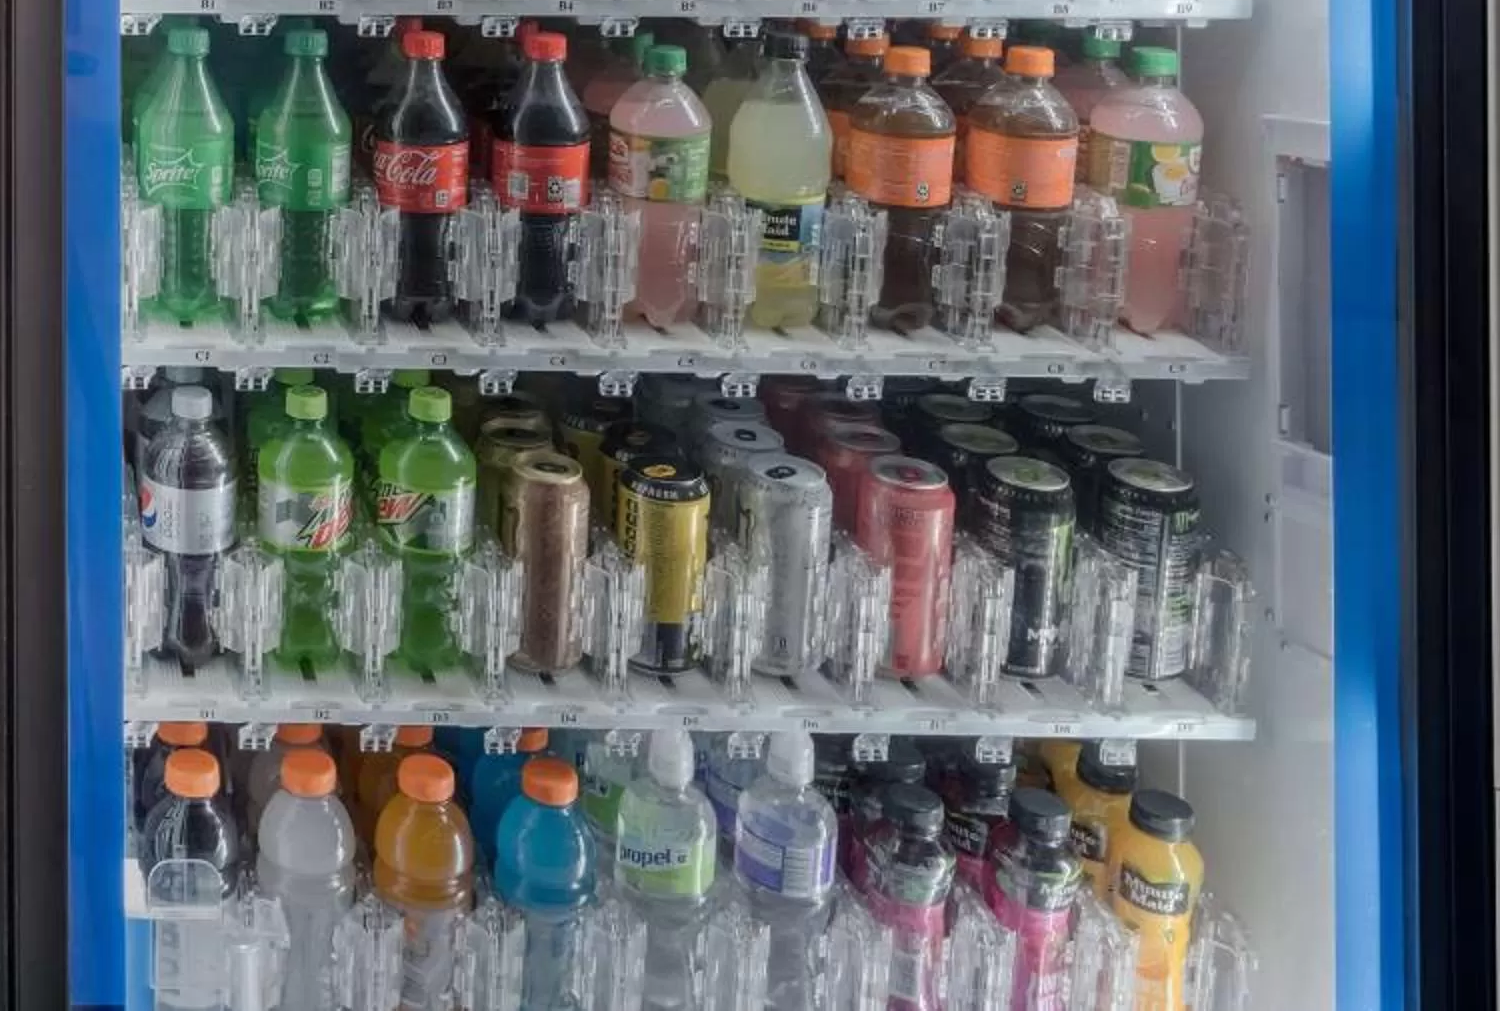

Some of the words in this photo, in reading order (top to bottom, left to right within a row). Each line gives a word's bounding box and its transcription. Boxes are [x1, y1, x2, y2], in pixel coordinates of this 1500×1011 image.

[319, 0, 335, 10] B2
[558, 0, 574, 11] B4
[195, 350, 210, 361] C1
[312, 354, 329, 364] C2
[314, 709, 330, 720] D2
[1124, 873, 1185, 901] Minute
[1130, 889, 1177, 913] Maid
